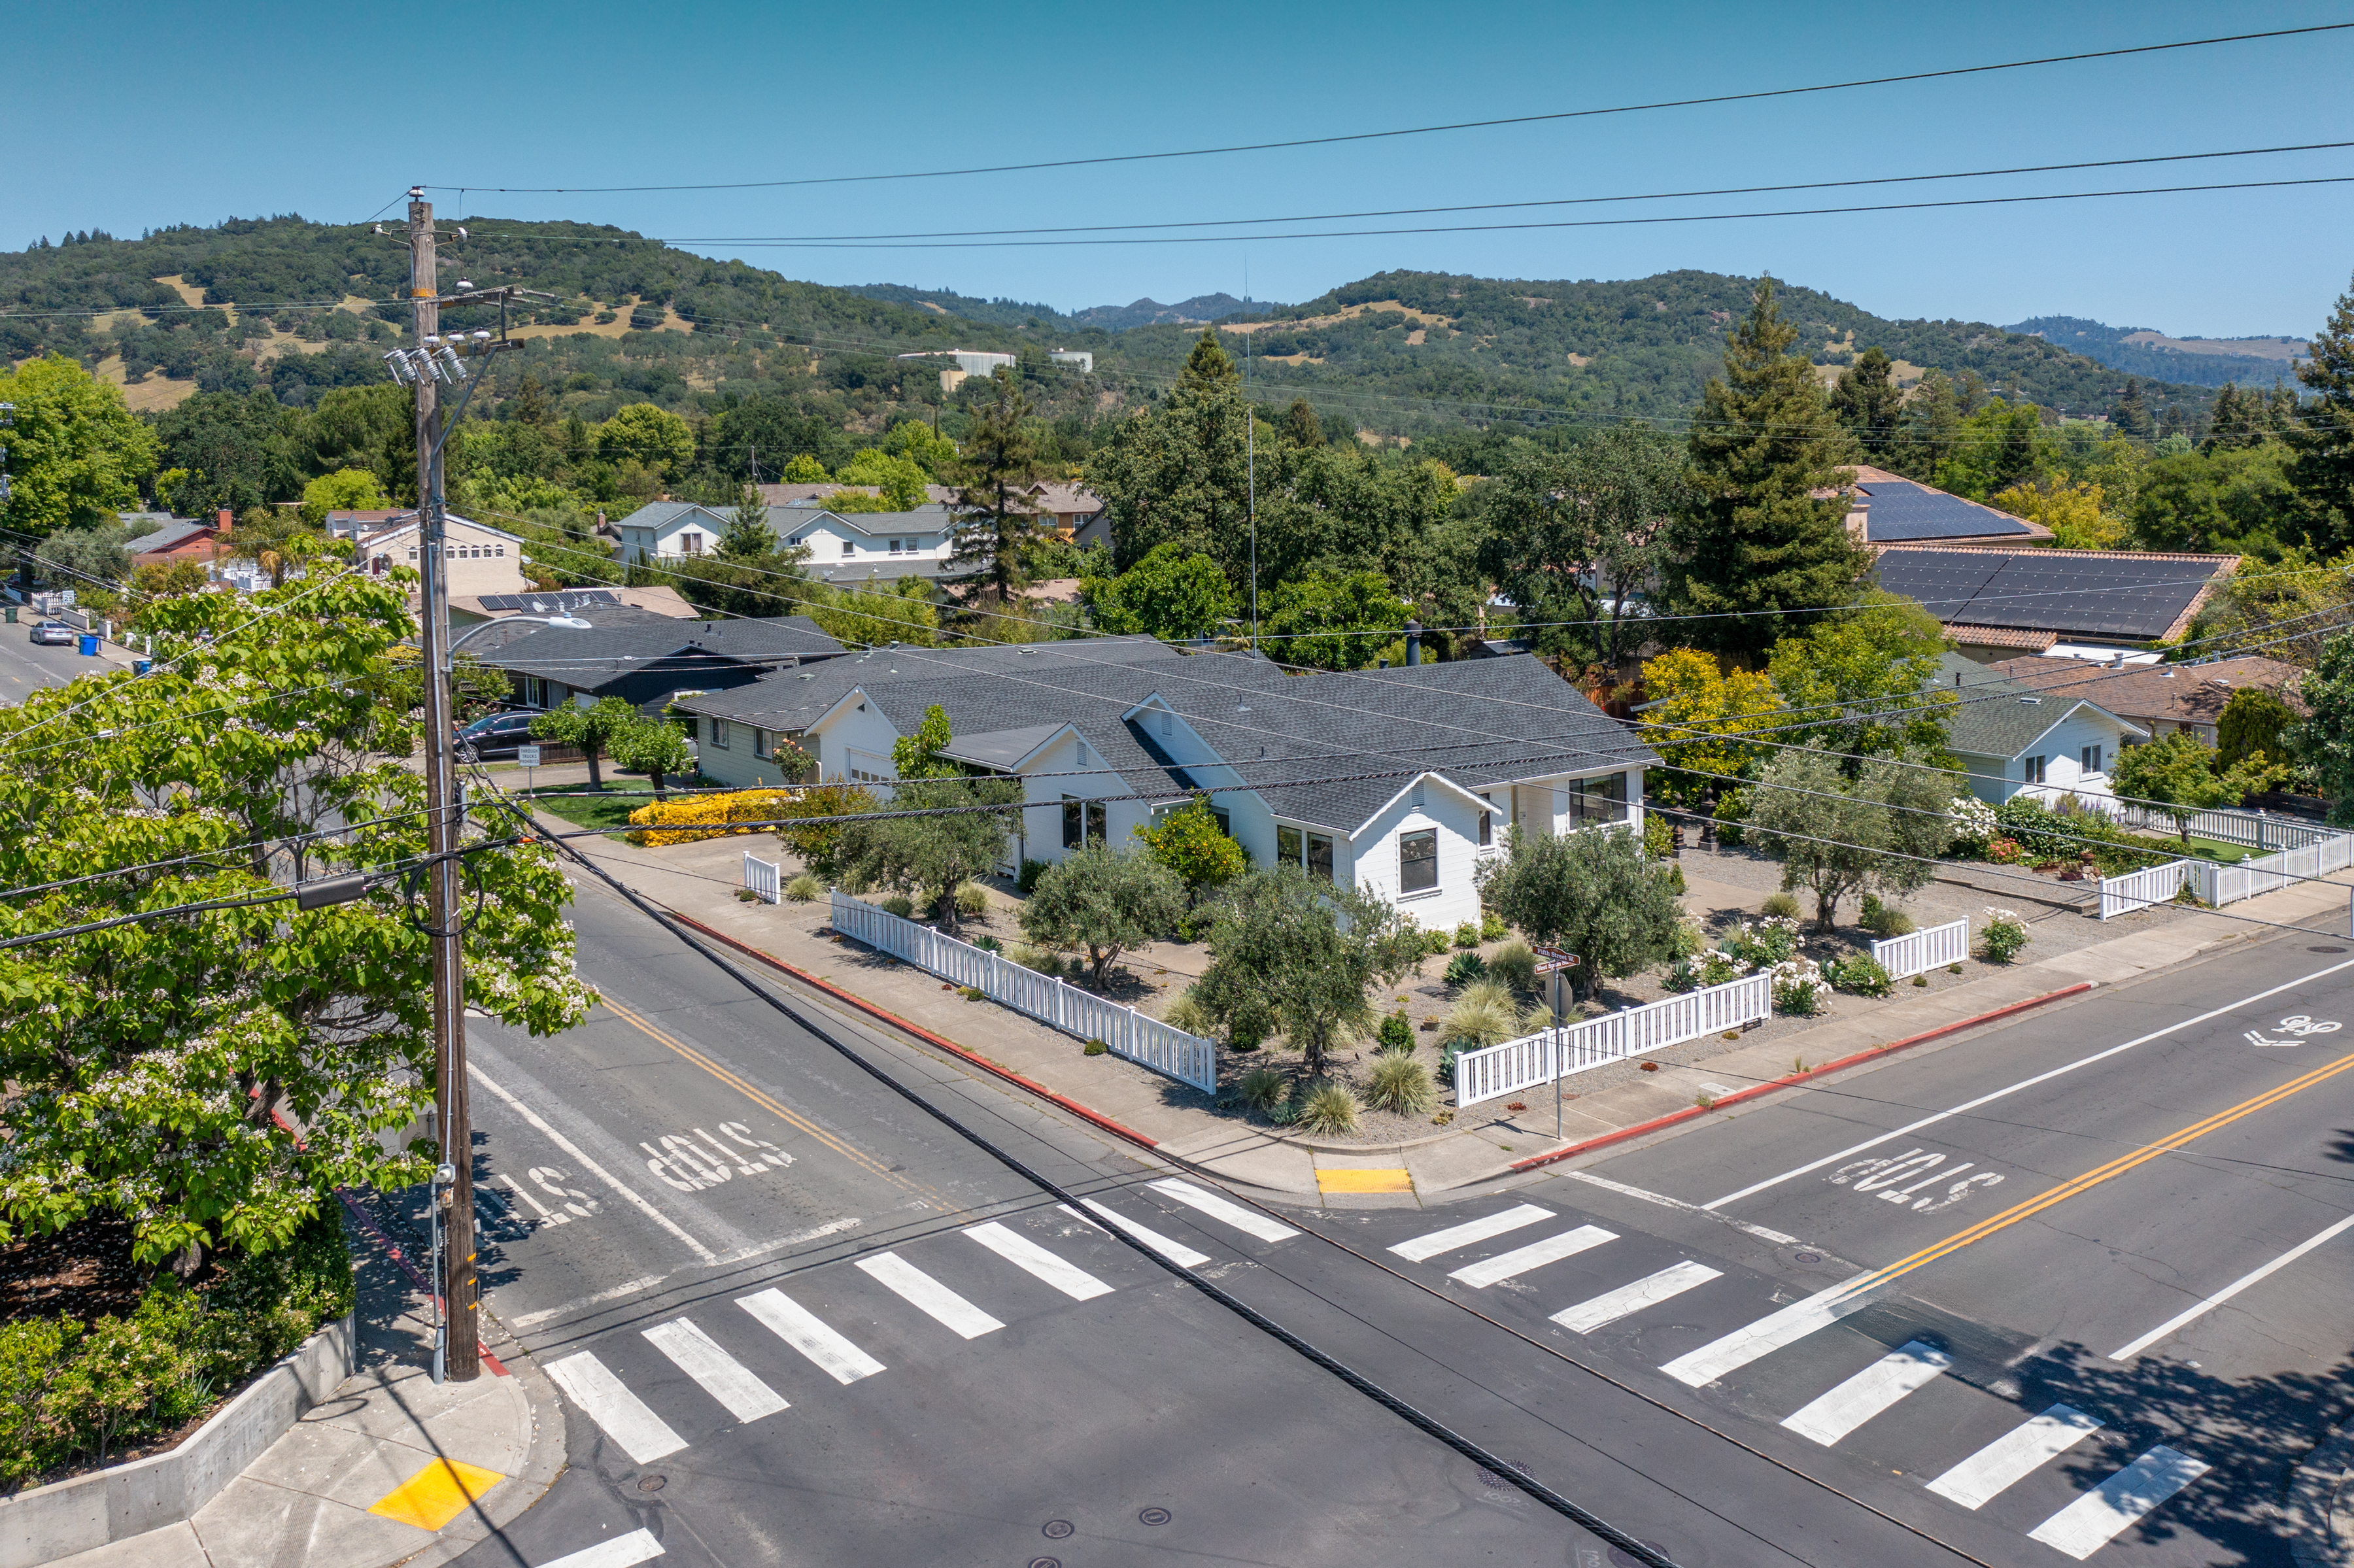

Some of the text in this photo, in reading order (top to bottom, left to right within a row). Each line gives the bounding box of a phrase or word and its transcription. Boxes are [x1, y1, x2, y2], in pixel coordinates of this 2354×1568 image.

[1551, 951, 1567, 960] Street
[639, 1121, 795, 1191] STOP
[1829, 1148, 2005, 1214] STOP
